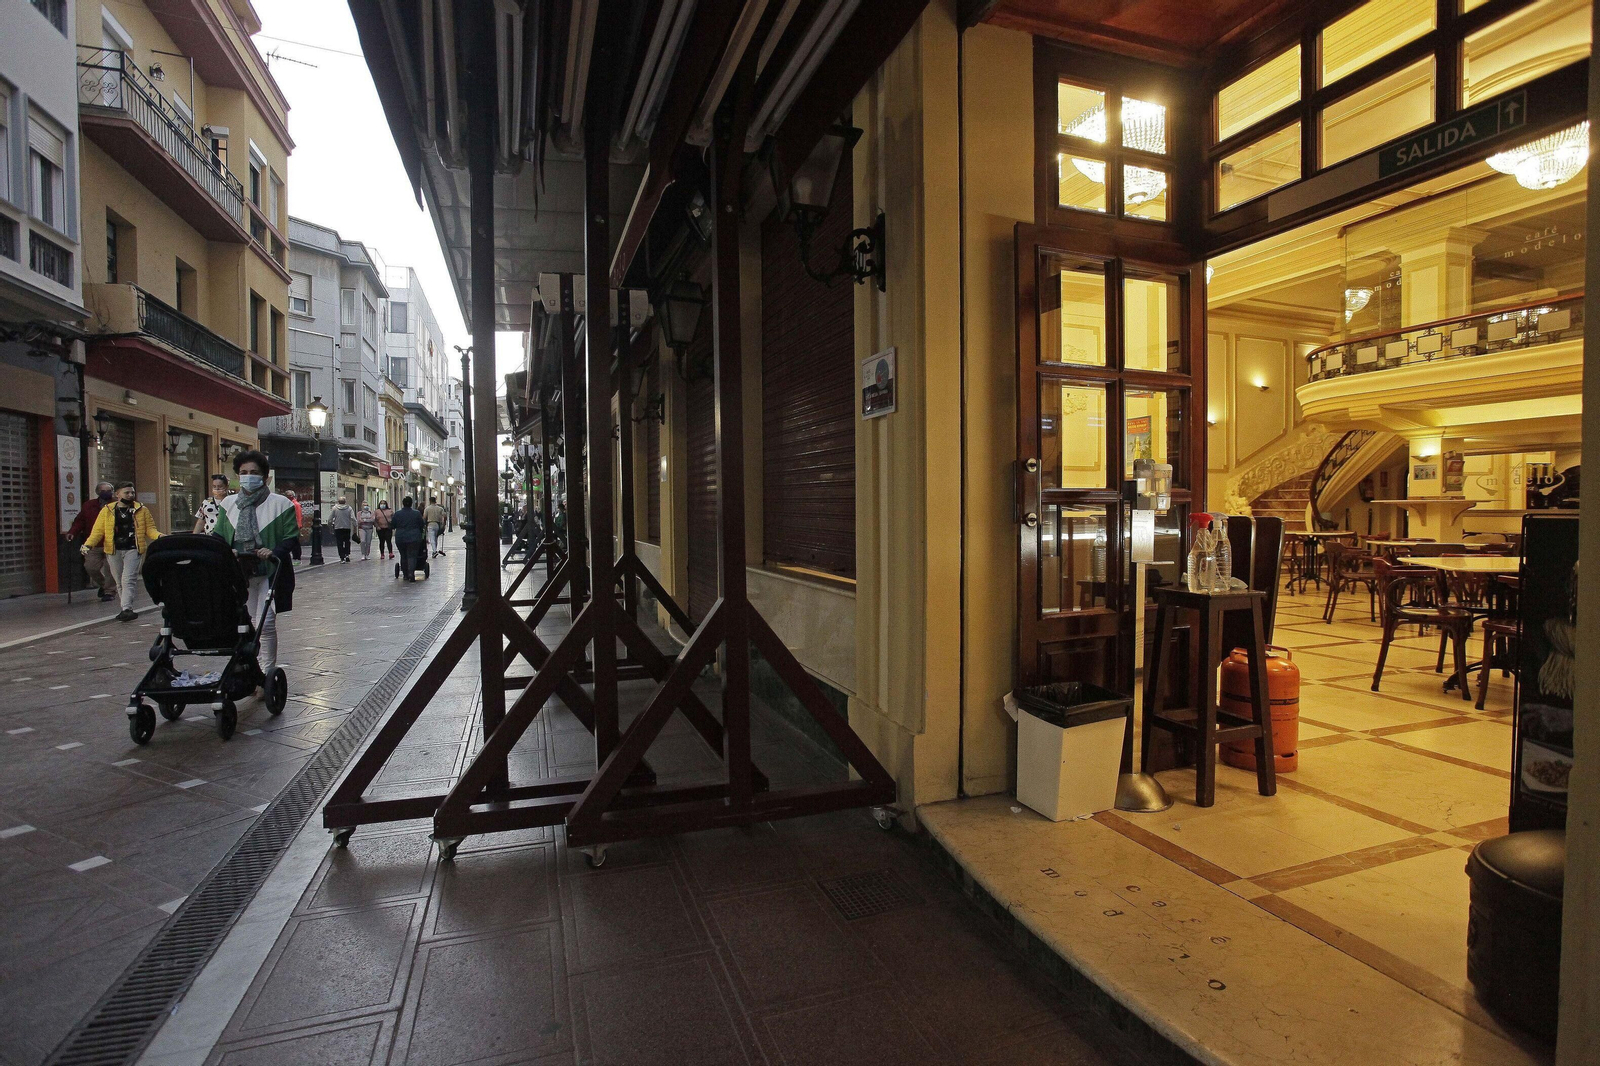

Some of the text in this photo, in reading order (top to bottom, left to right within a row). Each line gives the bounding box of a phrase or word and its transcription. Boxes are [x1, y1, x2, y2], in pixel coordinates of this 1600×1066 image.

[1396, 121, 1477, 167] SALIDA
[1503, 233, 1582, 259] modelo
[1525, 225, 1557, 241] café
